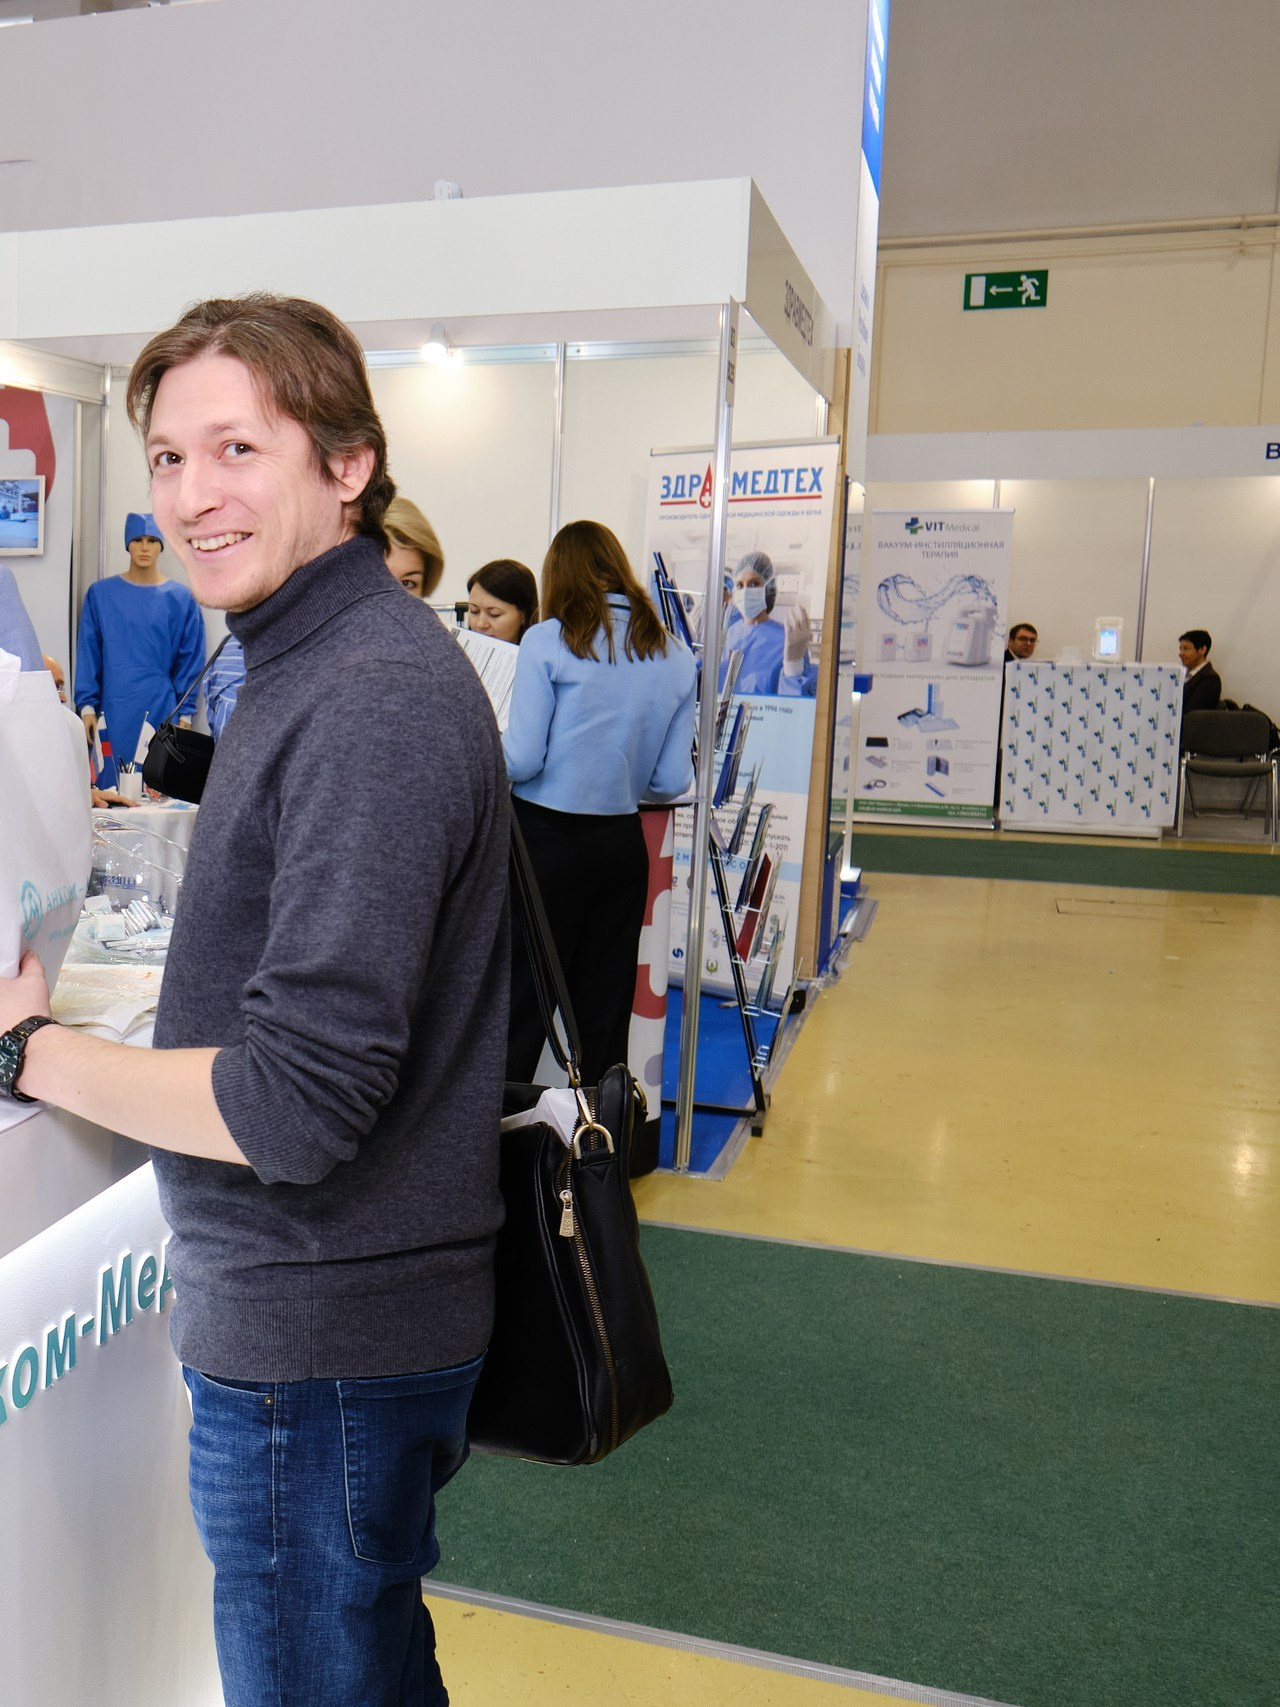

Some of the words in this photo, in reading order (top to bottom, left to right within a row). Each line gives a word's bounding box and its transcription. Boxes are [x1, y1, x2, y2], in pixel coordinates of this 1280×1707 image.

[1266, 442, 1280, 460] В
[660, 464, 823, 508] ЗДРАМЕДТЕХ
[925, 522, 944, 532] VIT
[945, 524, 980, 532] Medical
[878, 541, 1005, 549] ВАКУУМ-ИНСТИЛЛЯЦИОННАЯ
